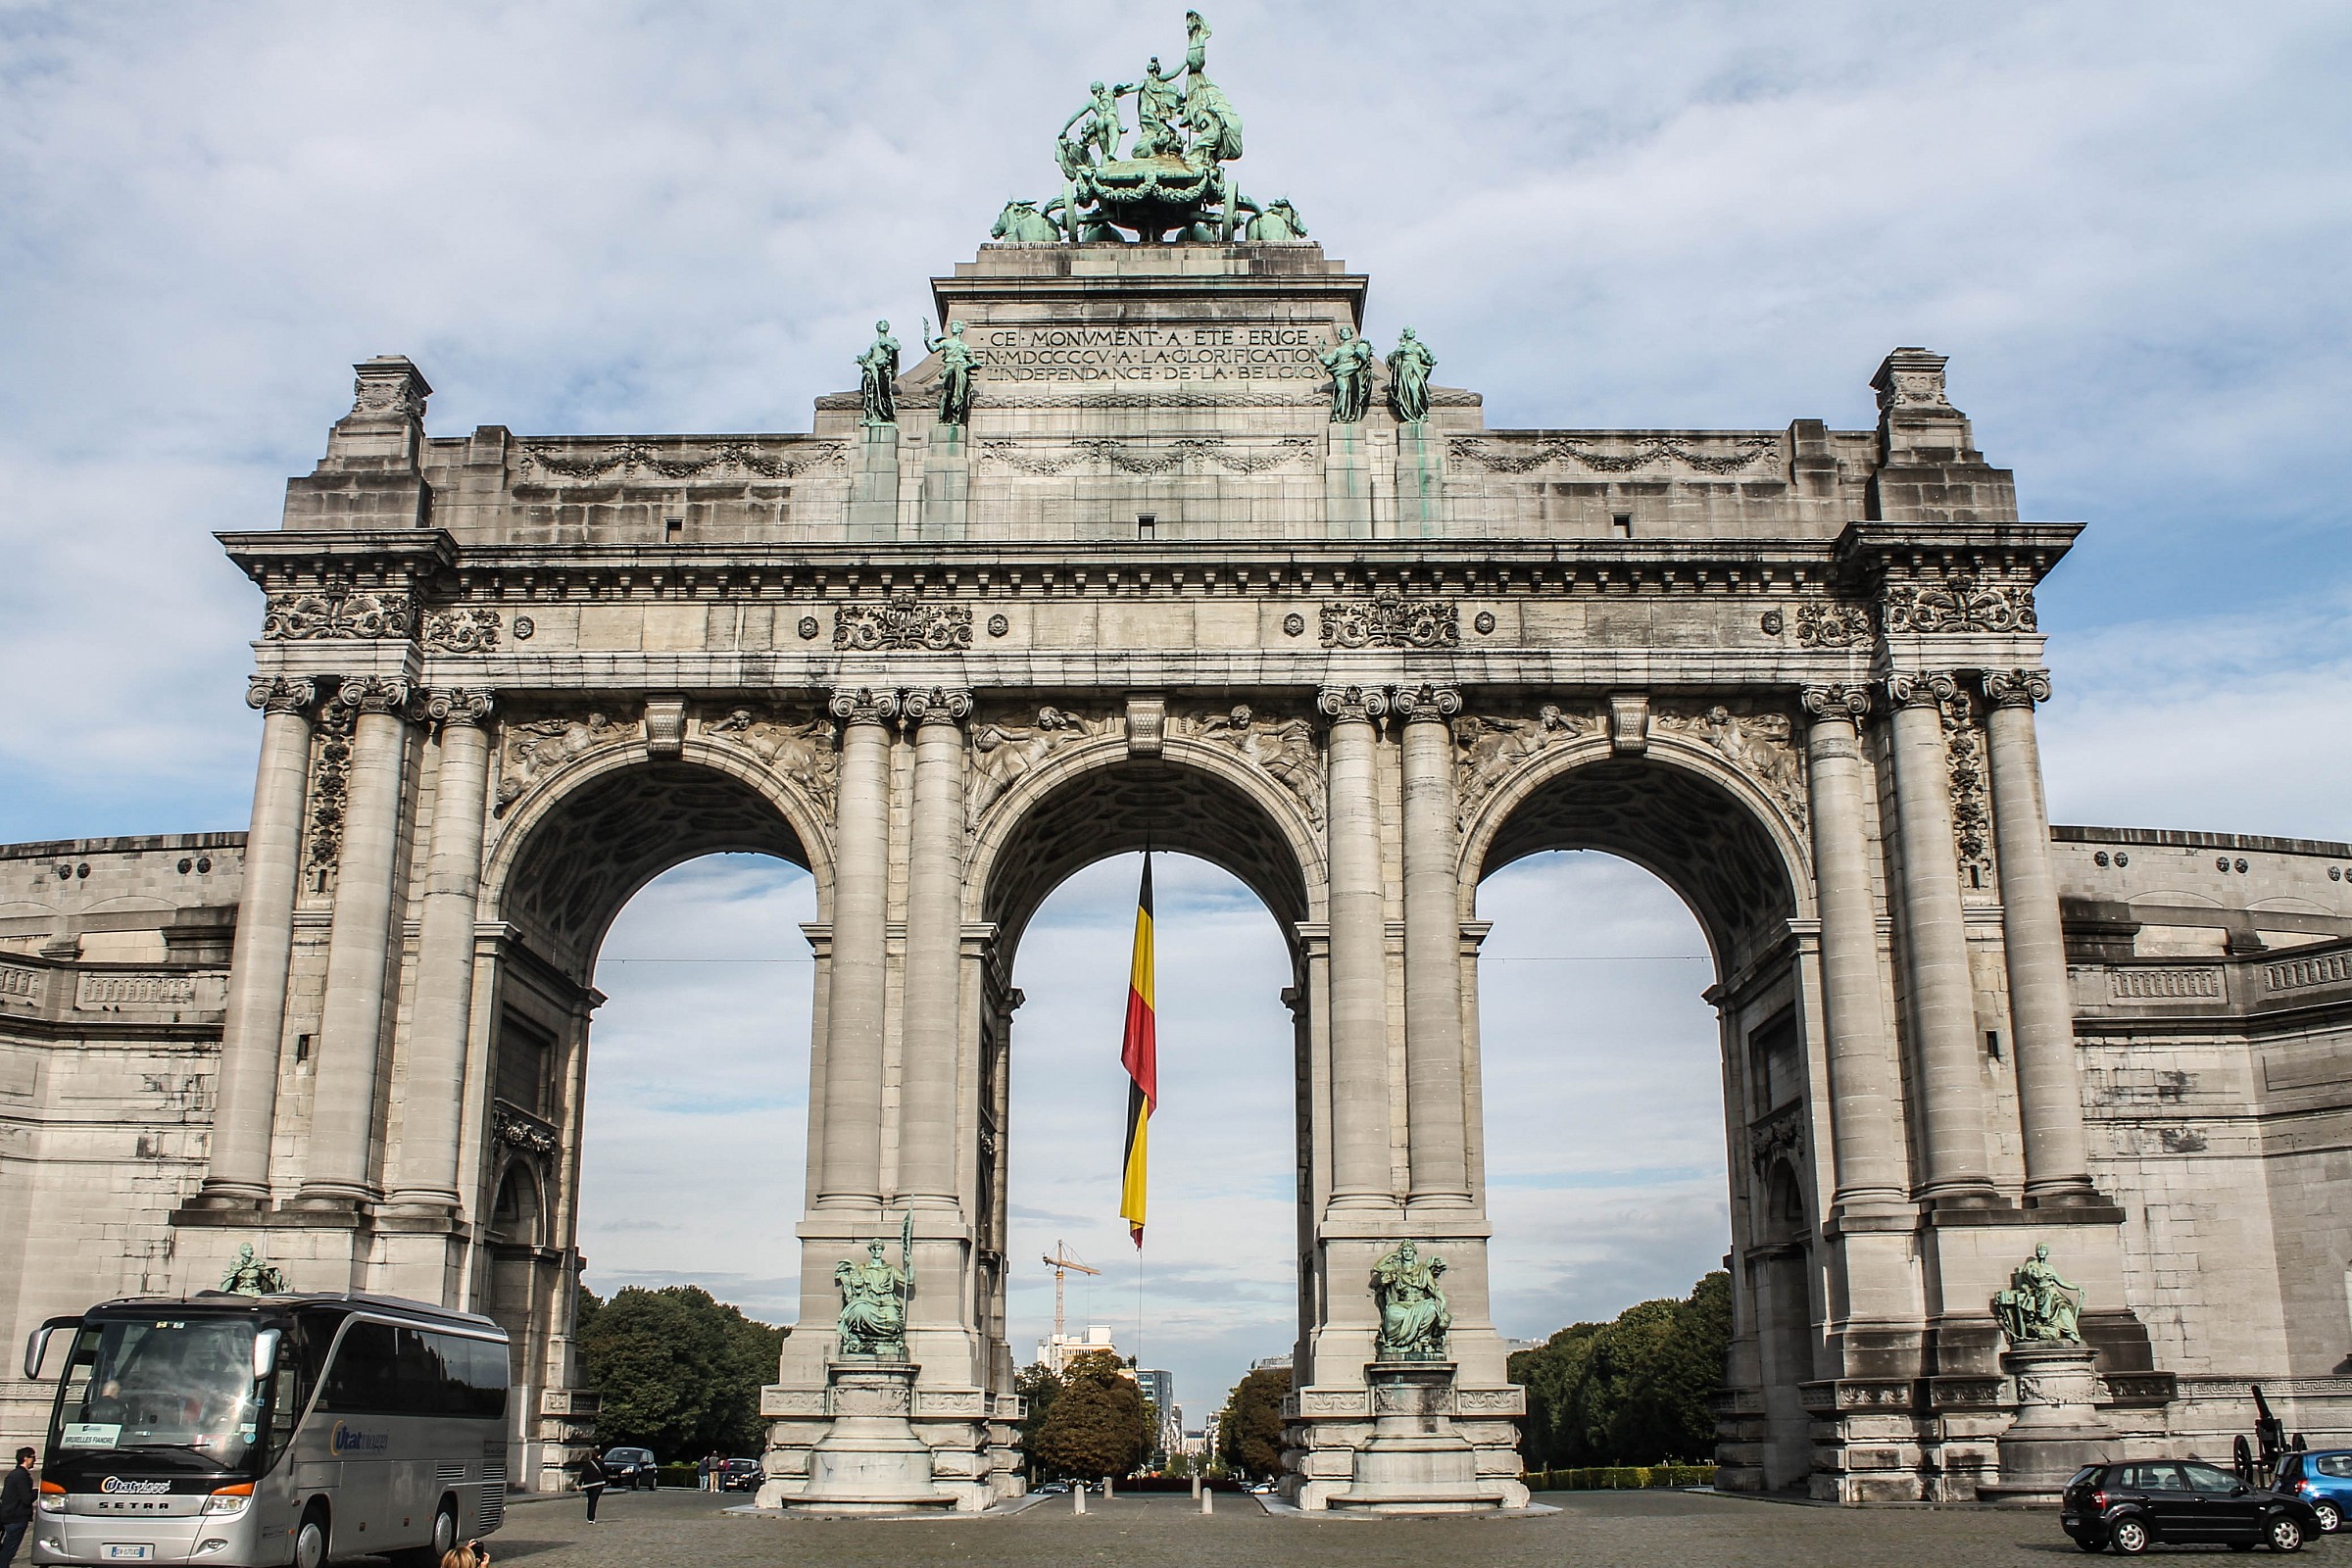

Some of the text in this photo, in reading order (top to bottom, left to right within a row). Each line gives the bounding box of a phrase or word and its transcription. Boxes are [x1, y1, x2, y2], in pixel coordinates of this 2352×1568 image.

[990, 329, 1308, 347] CE MONVMENT A ETE ERIGE
[973, 350, 1000, 365] EN
[1003, 350, 1111, 365] MDCCCCV
[1116, 349, 1133, 364] A
[1142, 349, 1169, 364] LA
[987, 367, 1152, 381] L'INDEPENDANCE
[1163, 367, 1191, 380] DE
[1200, 367, 1228, 380] LA
[1237, 366, 1329, 380] BELGIQV
[98, 1501, 170, 1510] SETRA
